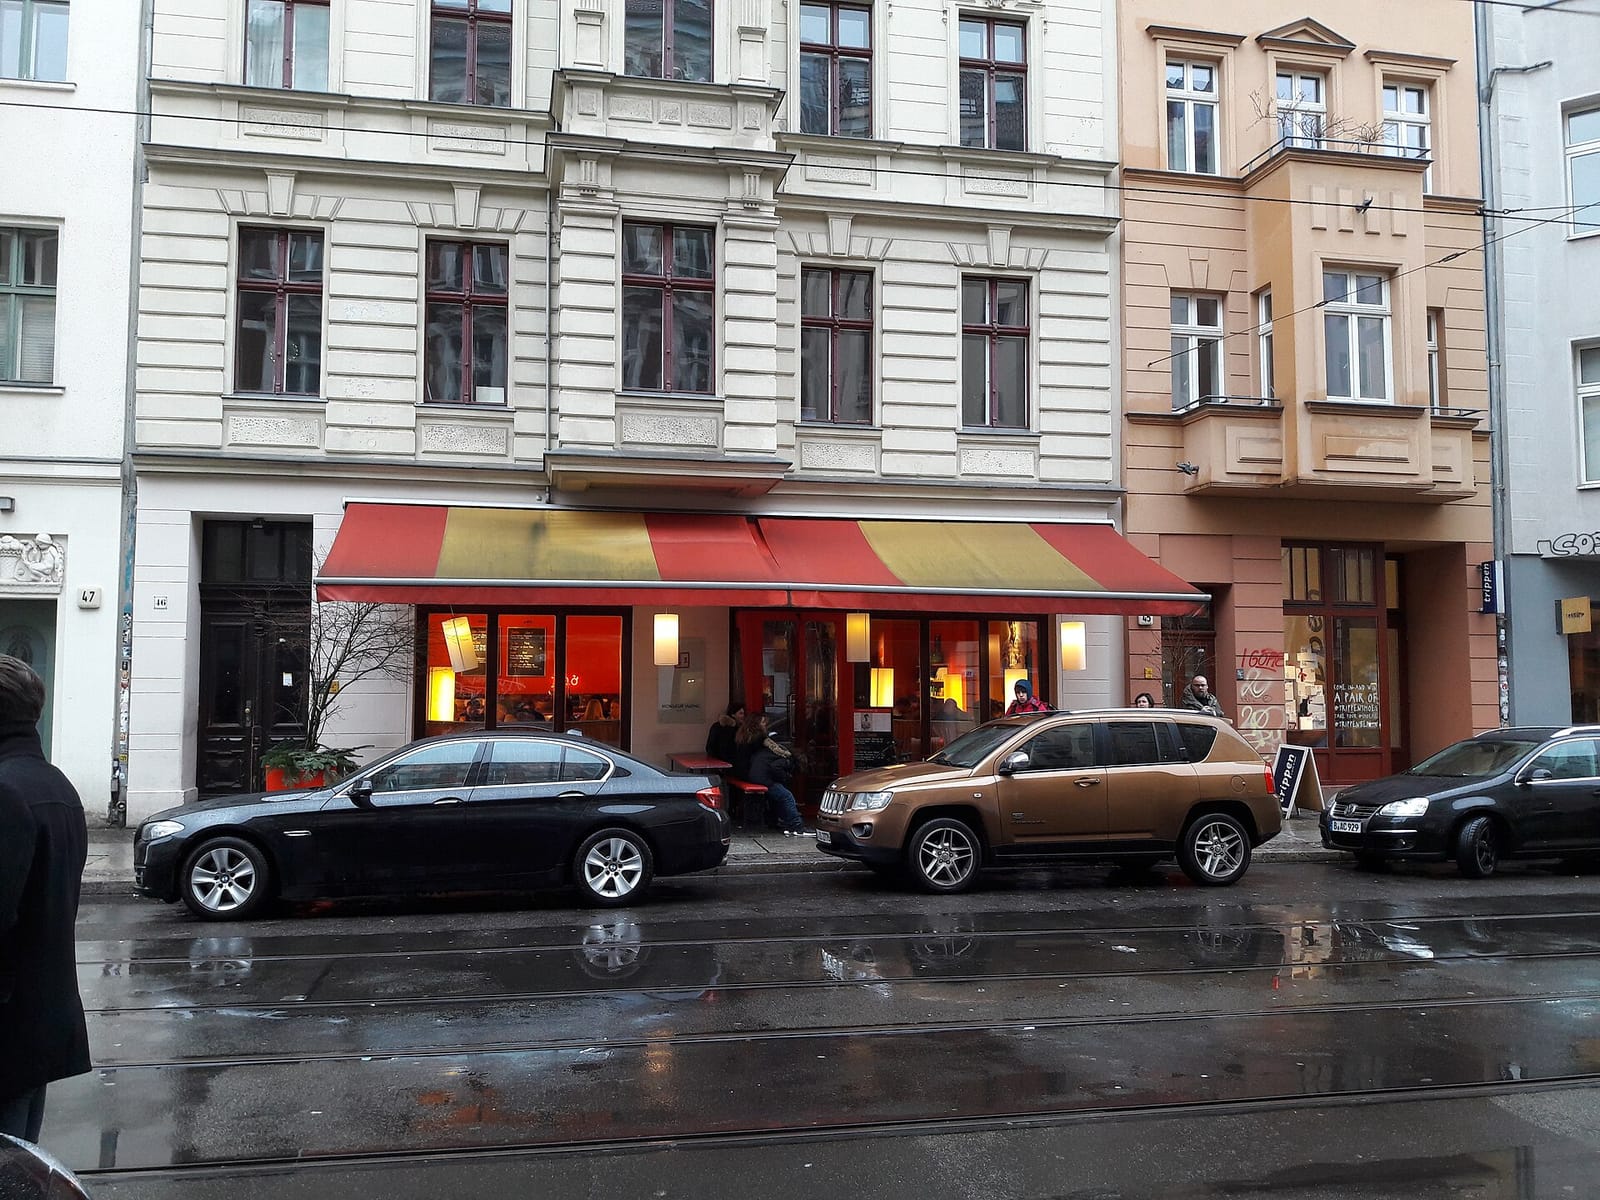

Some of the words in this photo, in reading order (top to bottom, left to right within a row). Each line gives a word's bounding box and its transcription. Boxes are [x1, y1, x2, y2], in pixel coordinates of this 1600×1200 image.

[1483, 563, 1492, 603] trippen
[82, 591, 95, 603] 47
[1334, 691, 1341, 703] A
[1344, 692, 1365, 703] PAIR
[1279, 753, 1296, 802] trippen
